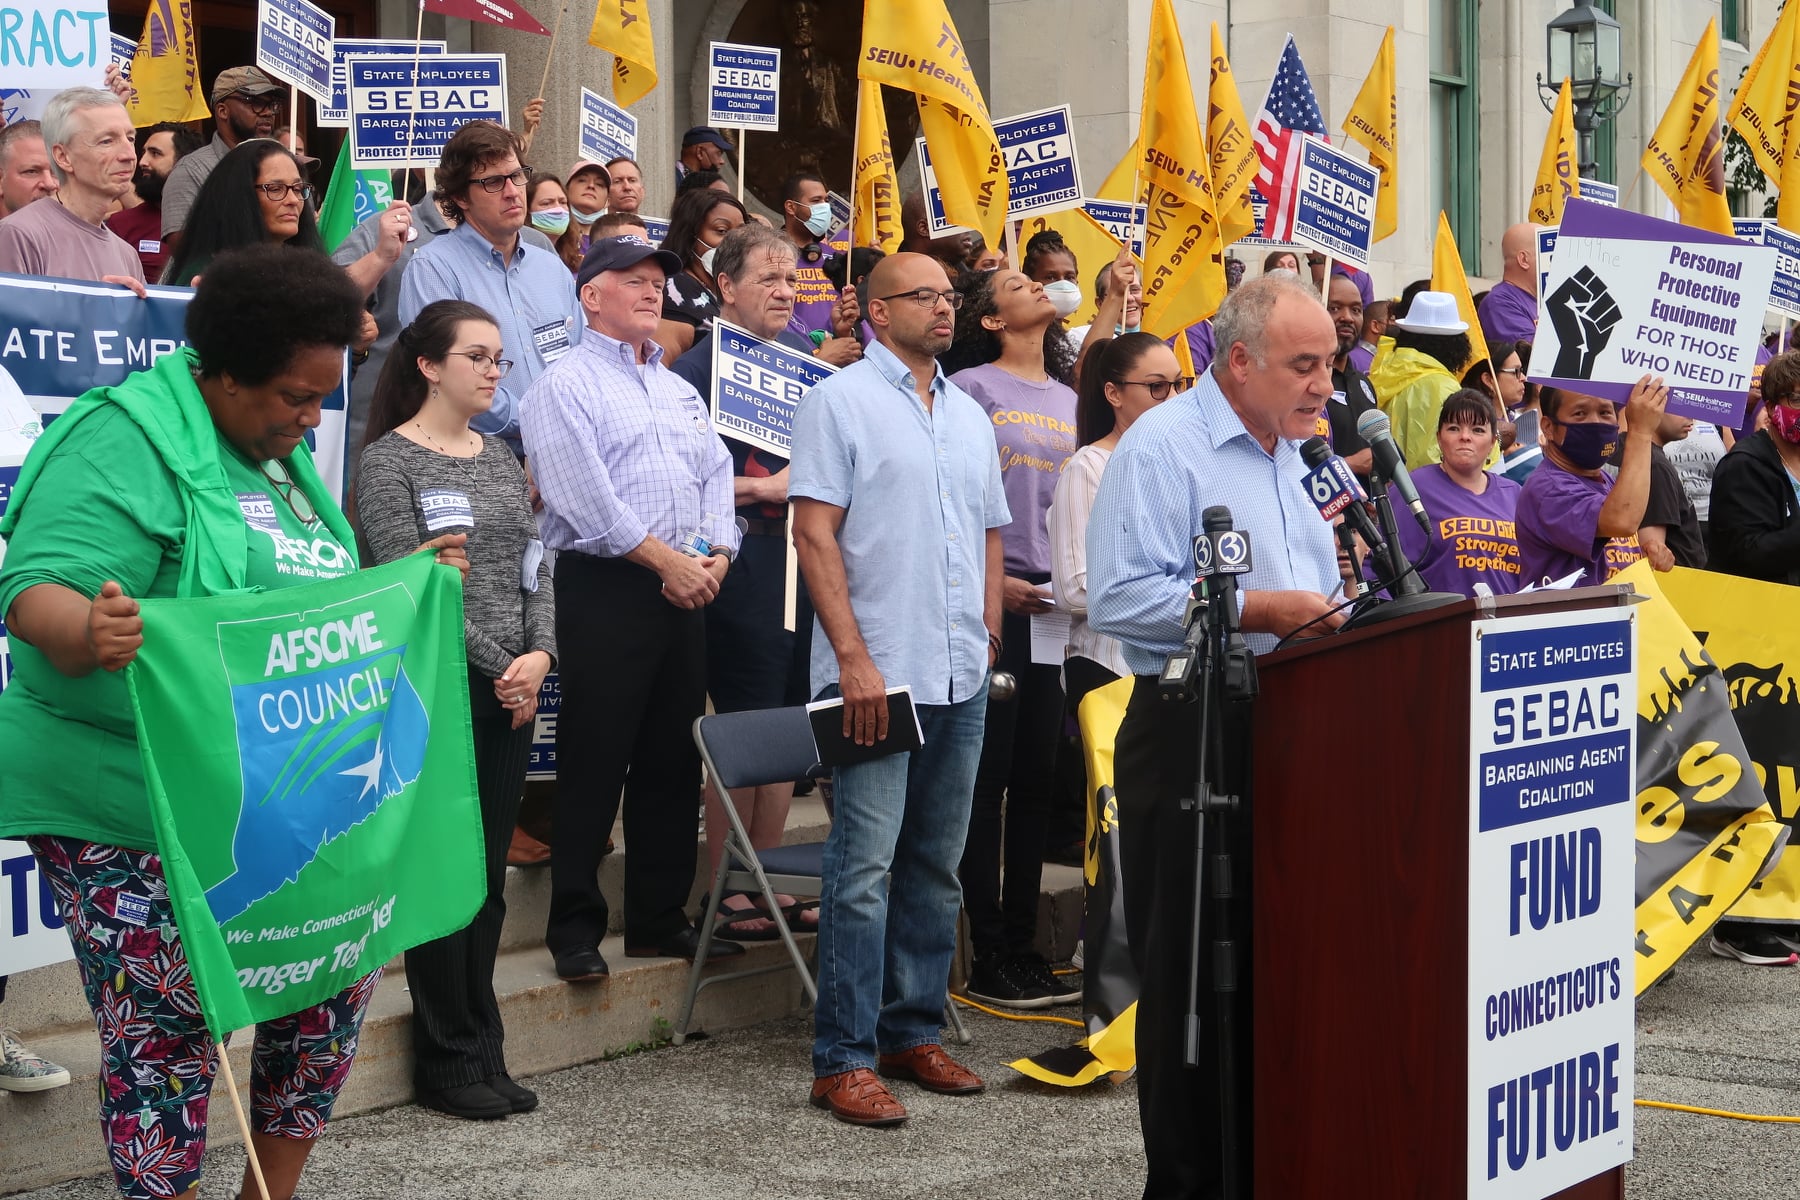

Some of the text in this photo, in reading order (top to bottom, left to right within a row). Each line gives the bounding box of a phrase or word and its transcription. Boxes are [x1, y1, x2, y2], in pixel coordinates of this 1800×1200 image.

[290, 3, 328, 33] EMPLOYEES
[0, 8, 107, 68] RACT
[268, 8, 325, 56] SEBAC
[264, 28, 328, 71] BARGAINING AGENT
[279, 47, 314, 72] COALITION
[738, 57, 773, 66] EMPLOYEES
[867, 47, 908, 68] SEIU
[260, 50, 284, 69] PROTECT
[285, 63, 305, 81] PUBLIC
[306, 76, 329, 96] SERVICES
[363, 70, 491, 80] STATE EMPLOYEES
[718, 70, 771, 88] SEBAC
[368, 89, 489, 111] SEBAC
[714, 90, 774, 101] BARGAINING AGENT
[728, 101, 760, 110] COALITION
[323, 110, 348, 118] PROT
[361, 118, 446, 129] BARGANING
[712, 112, 732, 120] PROTECT
[752, 114, 775, 122] SERVICES
[1350, 116, 1373, 134] SEIU
[588, 113, 630, 147] SEBAC
[358, 147, 443, 157] PROTECT PUBLI
[1145, 148, 1178, 175] SEIU
[1022, 164, 1066, 182] AGENT
[1310, 152, 1370, 188] STATE EMPLOYEES
[1024, 188, 1077, 209] SERVICES
[1309, 173, 1366, 215] SEBAC
[1303, 196, 1368, 232] BARGAINING AGENT
[1317, 215, 1352, 238] COALITION
[1297, 223, 1366, 260] PROTECT PUBLIC SERVICES
[1767, 236, 1782, 247] STATE
[1669, 246, 1742, 280] Personal
[794, 283, 835, 292] Stronge
[795, 292, 838, 304] Together
[1658, 272, 1741, 308] Protective
[1650, 298, 1737, 336] Equipment
[536, 328, 566, 344] SEBAC
[1636, 325, 1740, 362] FOR THOSE
[730, 340, 825, 382] STATE EMPLO
[1622, 348, 1670, 372] WHO
[1674, 360, 1724, 385] NEED
[1728, 372, 1746, 390] IT
[725, 385, 794, 418] BARGAINI
[719, 412, 768, 437] PROTECT
[993, 410, 1077, 435] CONTRAC
[1312, 466, 1341, 502] 61
[422, 498, 468, 508] SEBAC
[1323, 494, 1350, 517] NEWS
[1444, 519, 1492, 536] SEIU
[1222, 532, 1243, 564] 3
[1456, 537, 1520, 556] Stronge
[276, 562, 291, 574] We
[293, 565, 314, 578] Make
[264, 611, 383, 677] AFSCME
[1490, 642, 1624, 672] STATE EMPLOYEES
[258, 667, 389, 734] COUNCIL
[1493, 683, 1619, 745] SEBAC
[1486, 746, 1625, 786] BARGAINING AGENT
[1520, 779, 1594, 810] COALITION
[1510, 826, 1601, 936] FUND
[227, 929, 254, 944] We
[257, 924, 299, 943] Make
[1485, 957, 1621, 1042] CONNECTICUT'S
[1487, 1042, 1620, 1181] FUTURE
